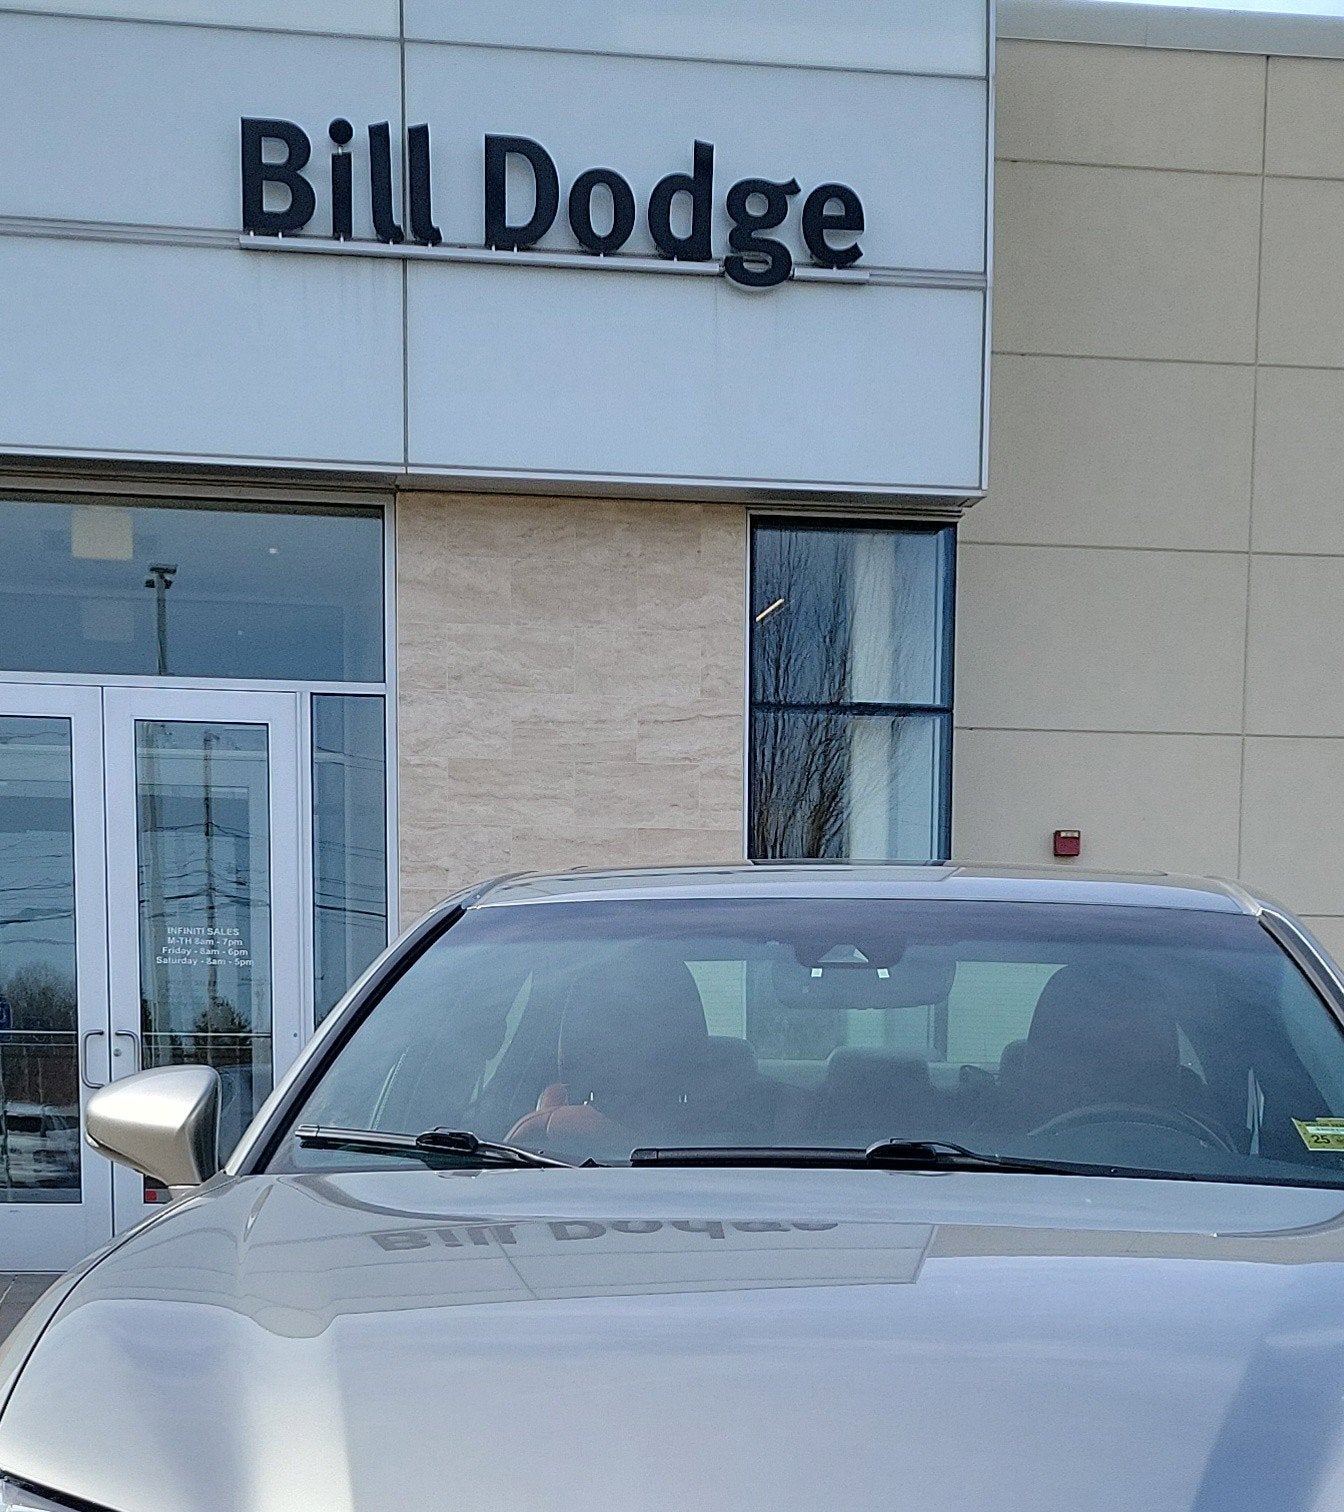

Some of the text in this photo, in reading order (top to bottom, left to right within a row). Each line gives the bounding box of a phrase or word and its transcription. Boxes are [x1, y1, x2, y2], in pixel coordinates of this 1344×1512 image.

[240, 116, 866, 287] Bill Dodge
[167, 926, 240, 936] INFINITI SALES
[167, 936, 192, 945] M-TH
[222, 938, 243, 947] 7pm
[162, 946, 192, 956] Friday
[228, 948, 249, 957] 6pm
[156, 956, 198, 966] Saturday
[234, 957, 254, 966] 5pm
[1311, 1134, 1331, 1144] 25
